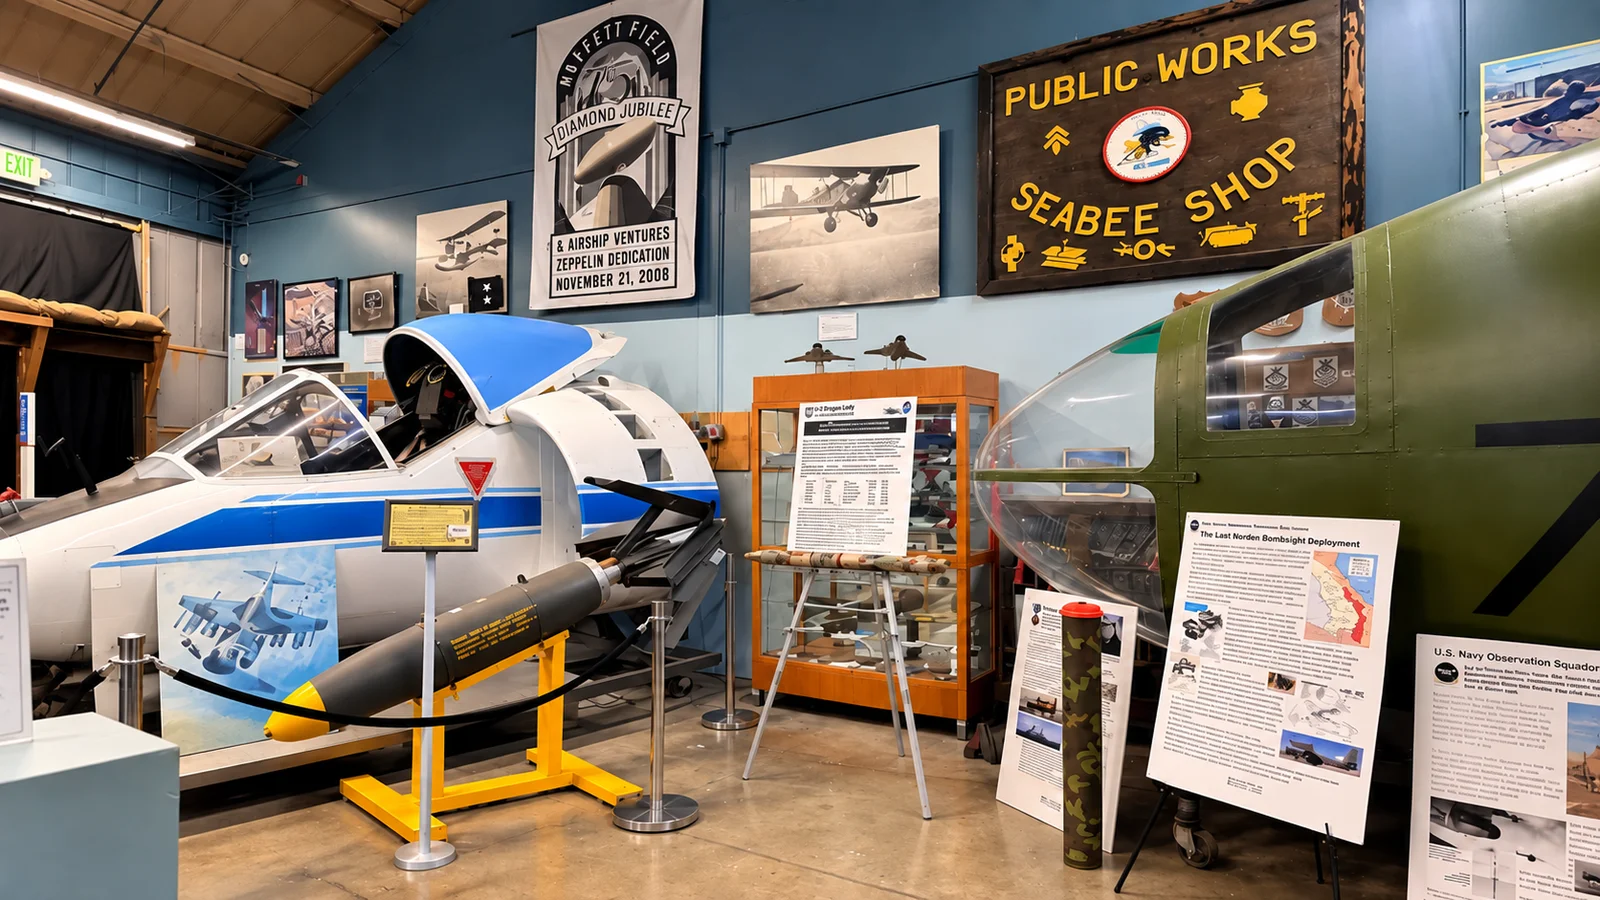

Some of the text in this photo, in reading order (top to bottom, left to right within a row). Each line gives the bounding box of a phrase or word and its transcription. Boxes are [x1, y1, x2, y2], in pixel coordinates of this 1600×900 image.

[560, 20, 670, 87] MOFFETT FIELD
[1005, 19, 1318, 117] PUBLIC WORKS
[557, 101, 675, 141] DIAMOND JUBILEE
[5, 151, 34, 178] EXIT
[1011, 137, 1297, 238] SEABEE SHOP
[556, 226, 670, 253] & AIRSHIP VENTURES
[556, 246, 670, 272] ZEPPELIN DEDICATION
[556, 267, 670, 291] NOVEMBER 21, 2008
[1200, 531, 1361, 549] The Last Norden Bombsight Deployment
[1434, 647, 1456, 658] U.S.
[1458, 650, 1484, 662] Navy
[1486, 652, 1551, 667] Observation
